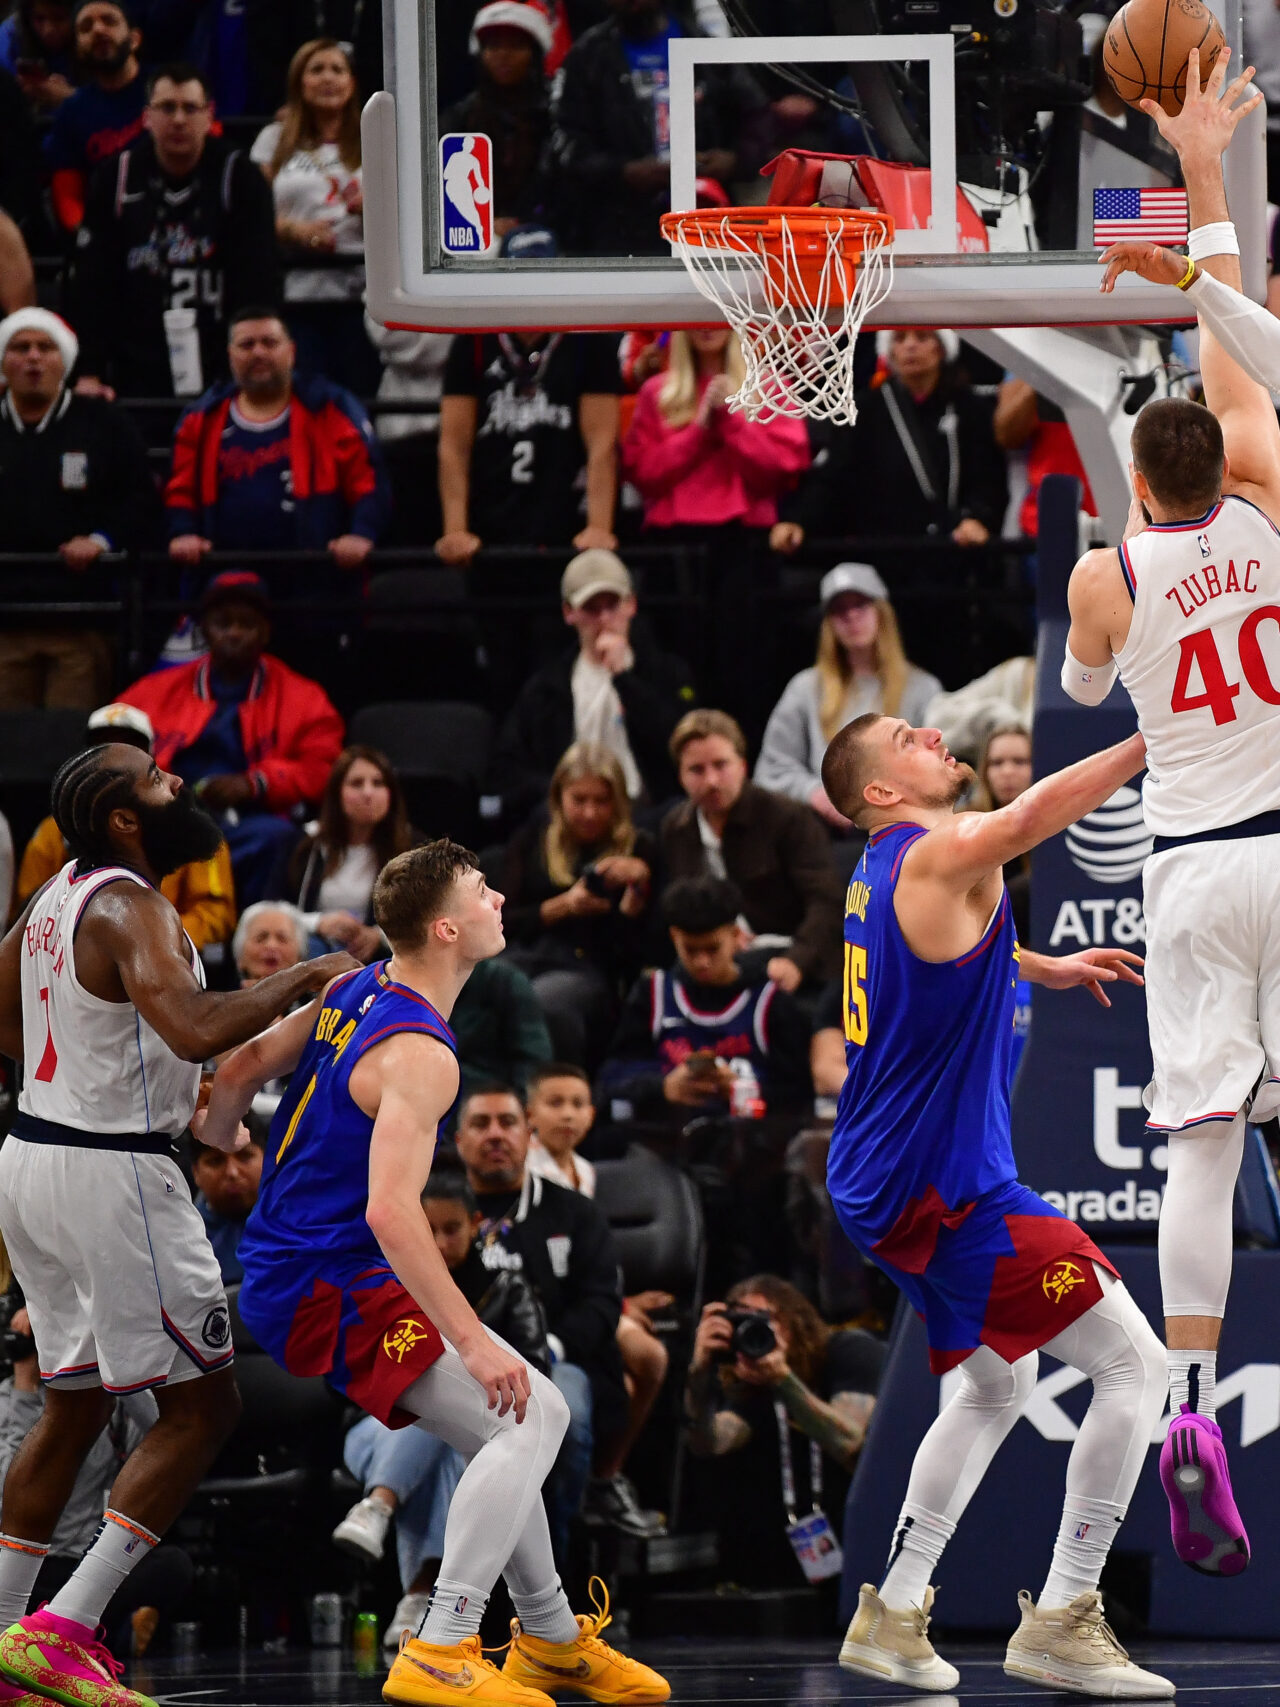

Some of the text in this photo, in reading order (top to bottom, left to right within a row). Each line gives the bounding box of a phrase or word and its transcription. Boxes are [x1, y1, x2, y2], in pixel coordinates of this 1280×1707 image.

[449, 227, 474, 246] NBA
[171, 268, 223, 320] 24
[511, 440, 534, 481] 2
[1165, 559, 1260, 618] ZUBAC
[1049, 898, 1145, 947] AT&
[843, 939, 868, 1047] 15
